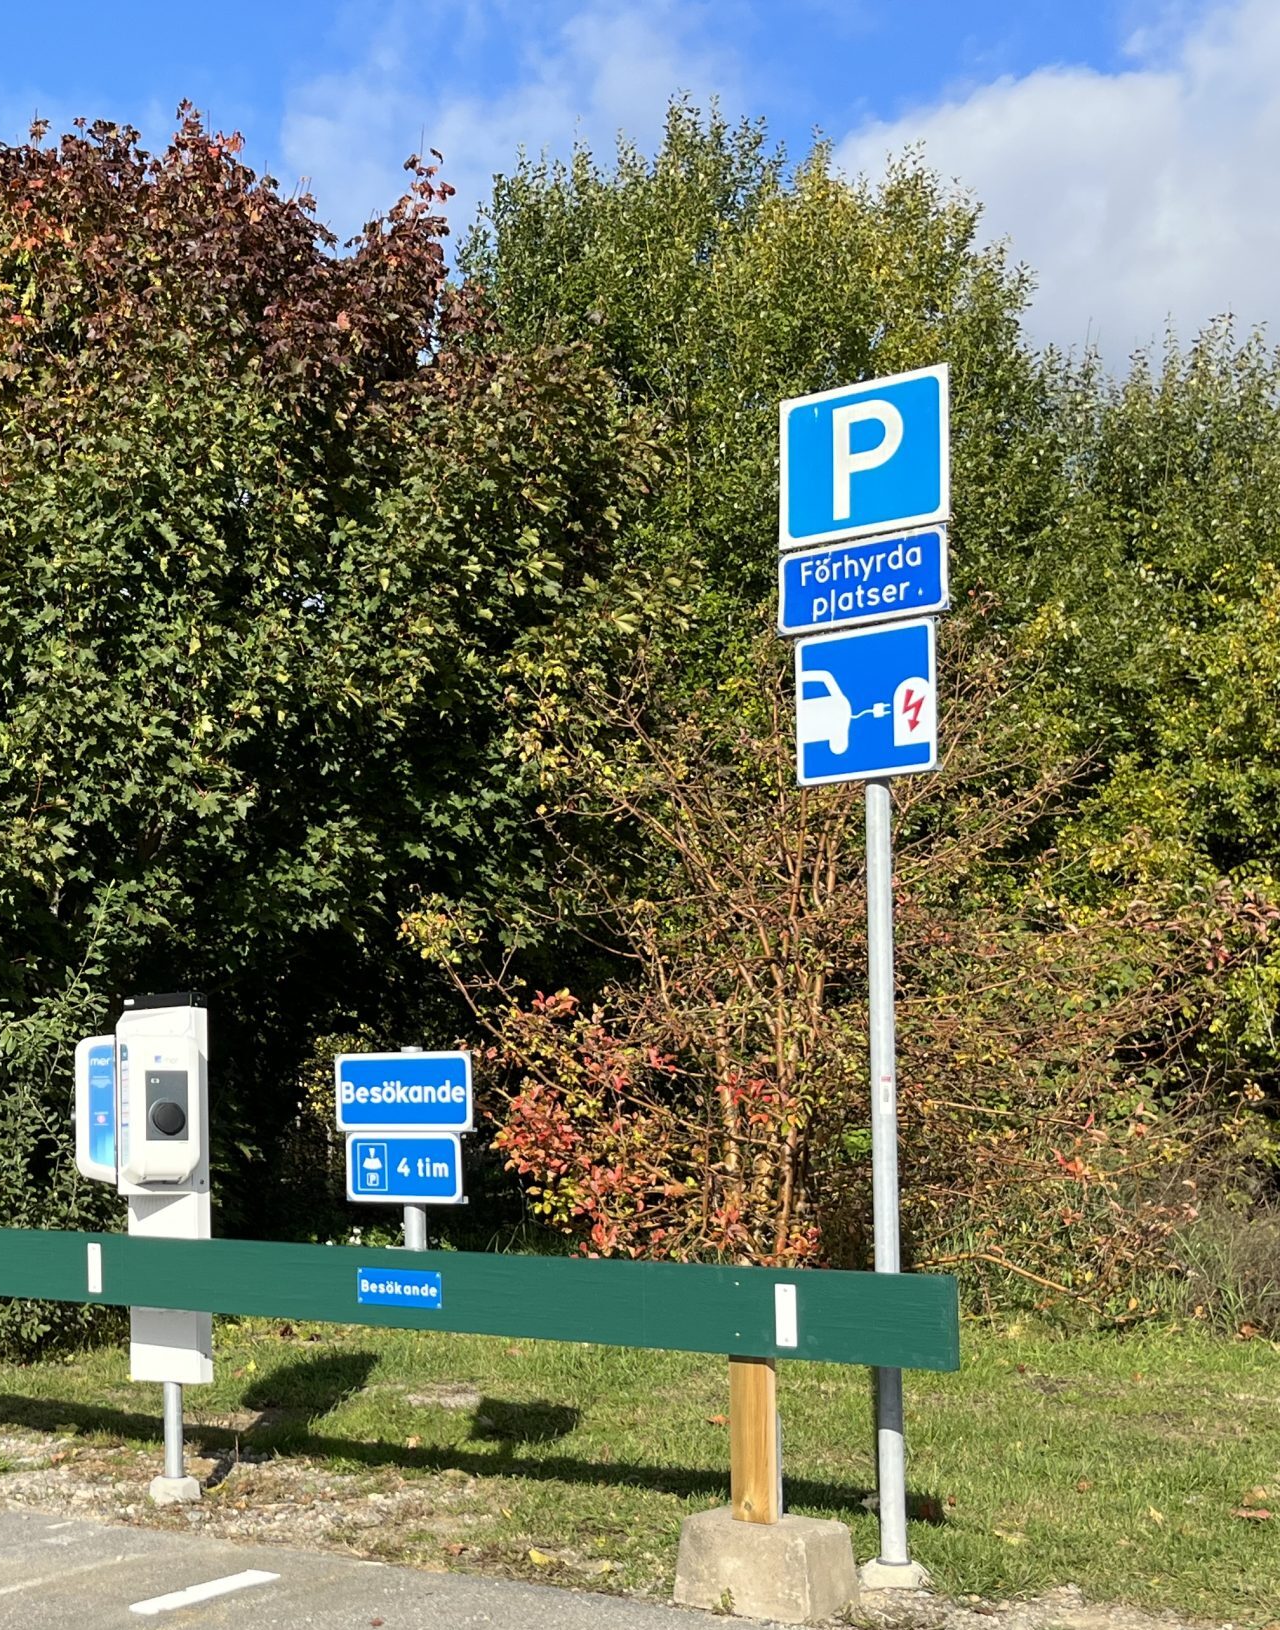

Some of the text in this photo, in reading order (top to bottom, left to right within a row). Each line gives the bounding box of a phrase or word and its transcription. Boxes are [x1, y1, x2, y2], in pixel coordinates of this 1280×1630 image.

[832, 399, 904, 521] P
[801, 544, 921, 587] Förhyrda
[812, 581, 910, 622] platser
[341, 1080, 465, 1104] Besökande
[396, 1157, 449, 1178] 4 tim
[360, 1279, 438, 1297] Besökande
